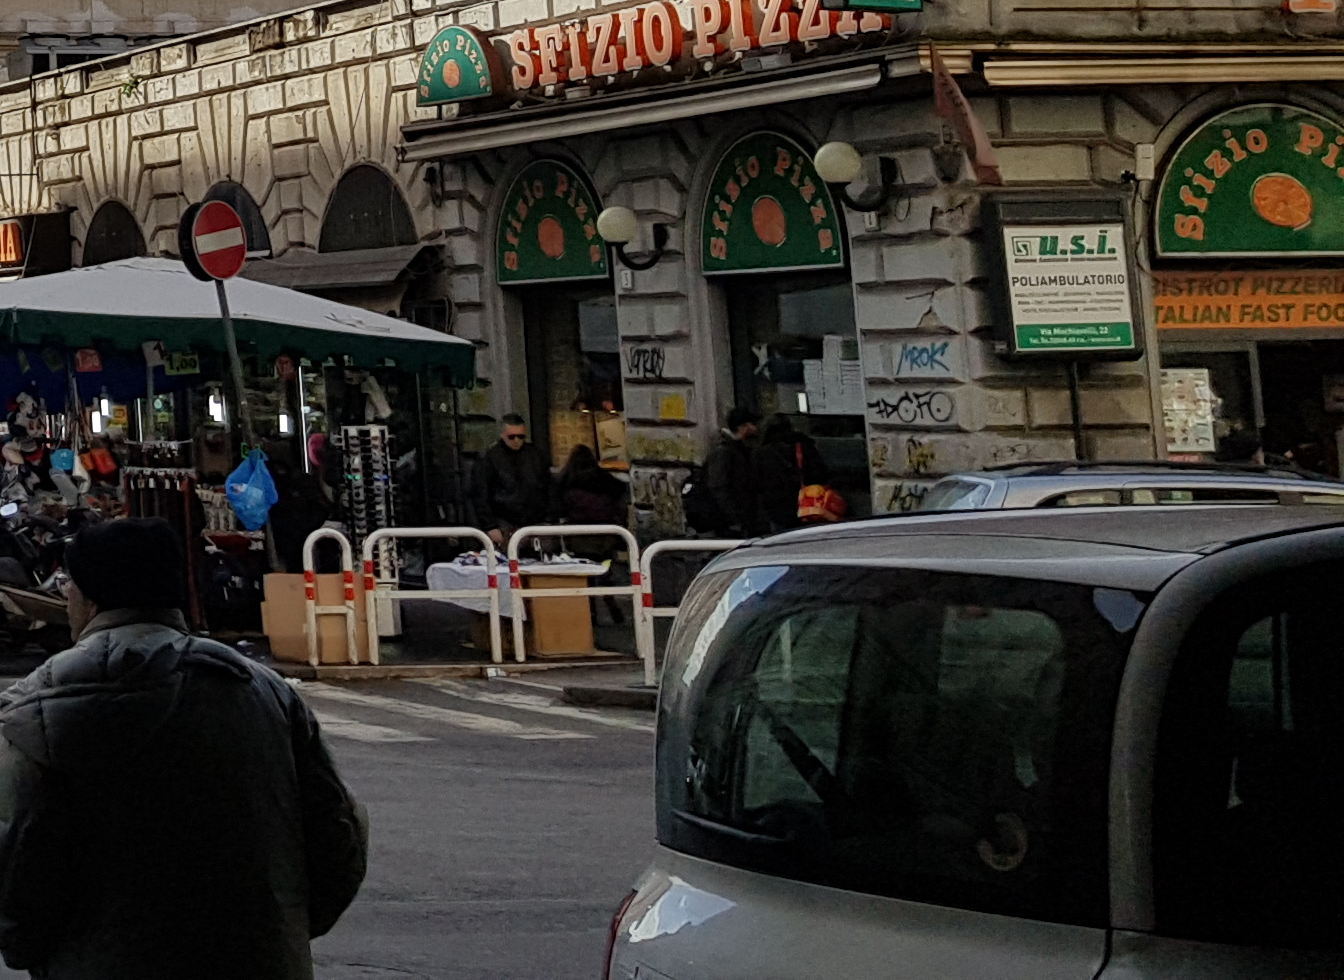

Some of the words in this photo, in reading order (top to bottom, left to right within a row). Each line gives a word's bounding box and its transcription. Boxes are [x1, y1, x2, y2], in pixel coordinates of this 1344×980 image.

[1175, 128, 1269, 242] Sfizio
[1039, 229, 1117, 256] u.s.i.
[1011, 273, 1126, 287] POLIAMBULATORIO
[1154, 303, 1233, 324] TALIAN
[1239, 302, 1297, 323] FAST
[1302, 301, 1344, 323] FOO
